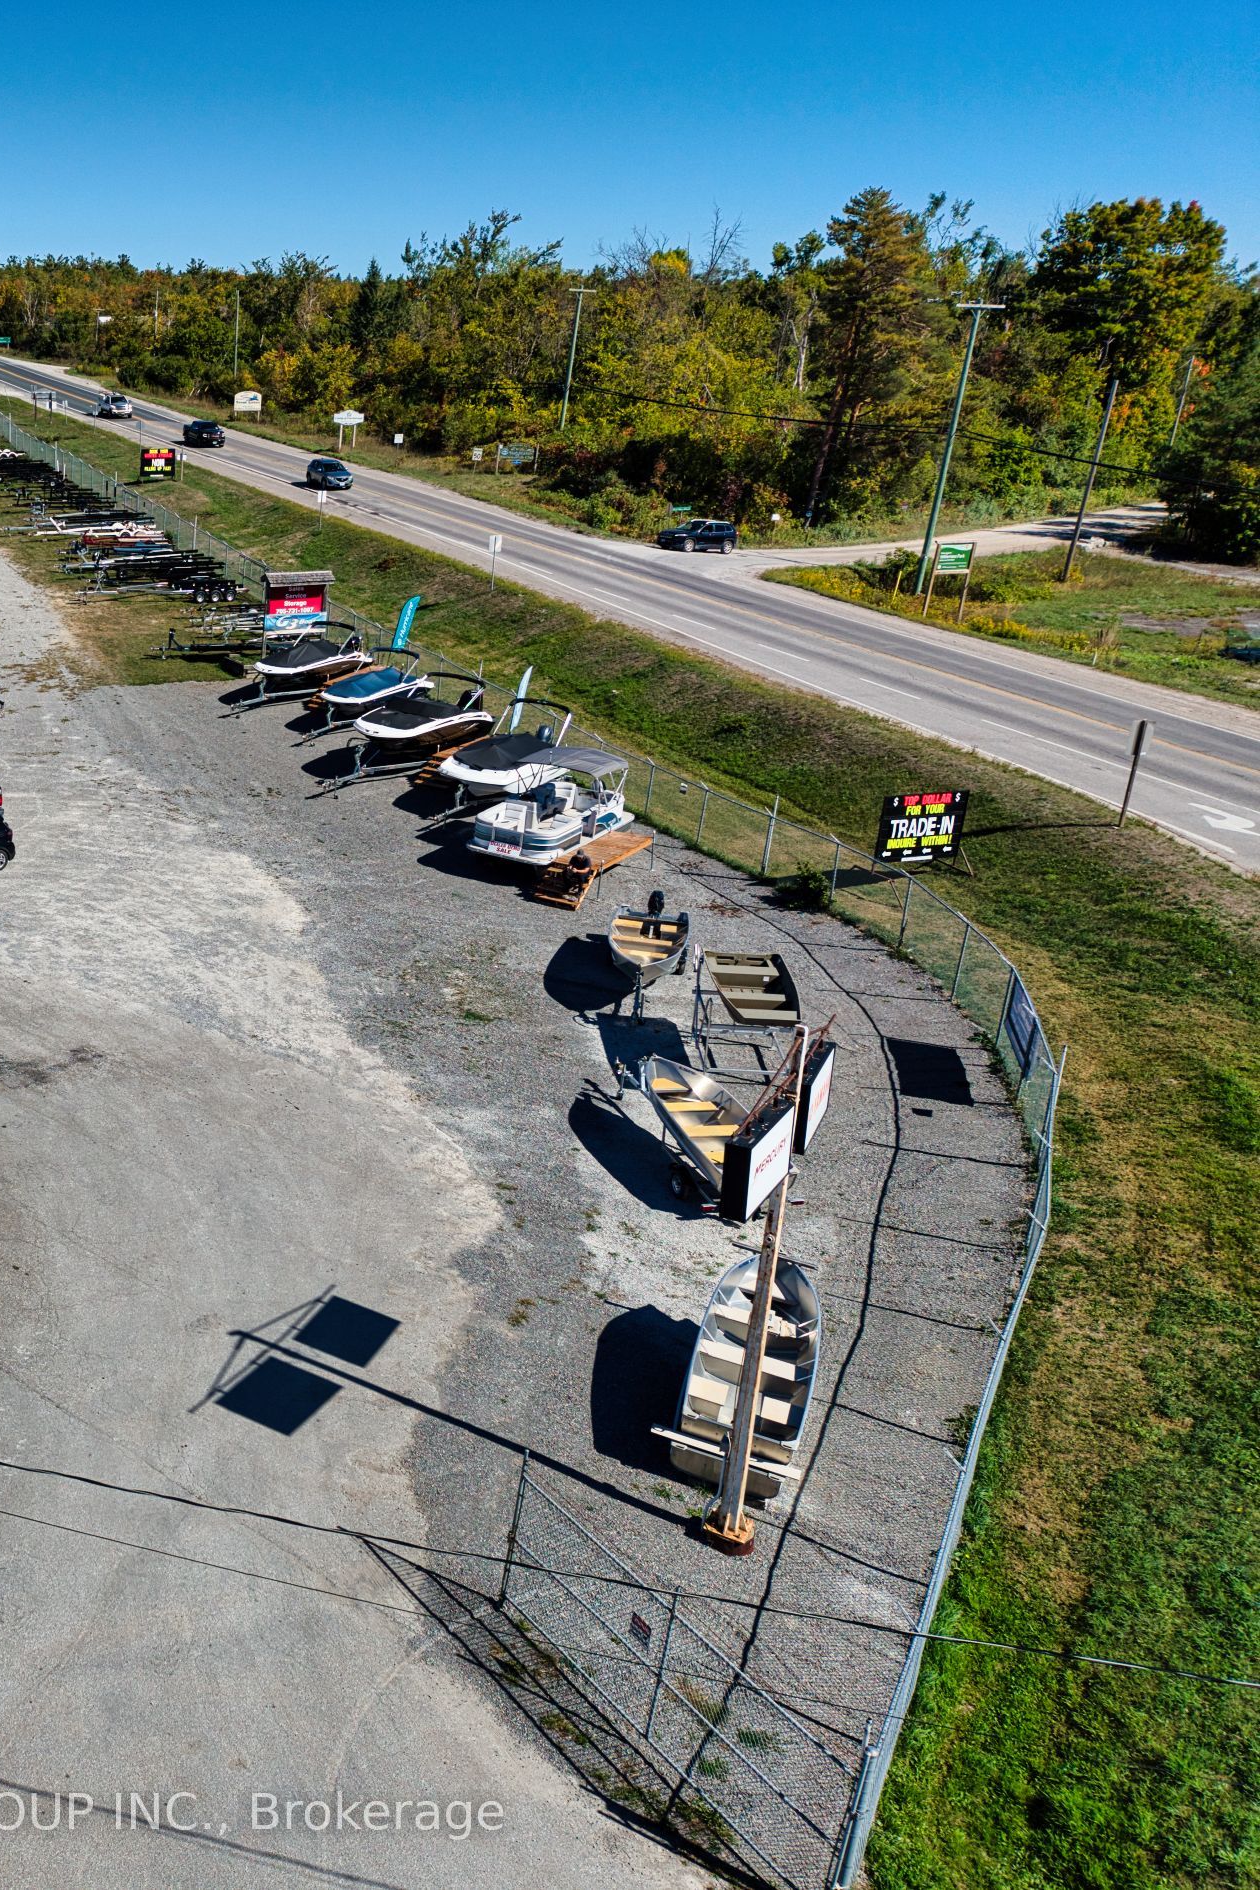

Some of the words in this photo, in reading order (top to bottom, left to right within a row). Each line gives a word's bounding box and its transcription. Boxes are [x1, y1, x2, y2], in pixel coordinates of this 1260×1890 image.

[151, 458, 165, 467] NOW
[892, 796, 900, 808] $
[904, 795, 920, 807] TOP
[921, 792, 953, 805] DOLLAR
[954, 792, 961, 802] $
[905, 805, 922, 816] FOR
[925, 803, 946, 815] YOUR
[890, 815, 956, 839] TRADE-IN
[886, 837, 918, 850] INQUIRE
[920, 834, 953, 847] WITHIN!
[496, 847, 511, 855] SALE
